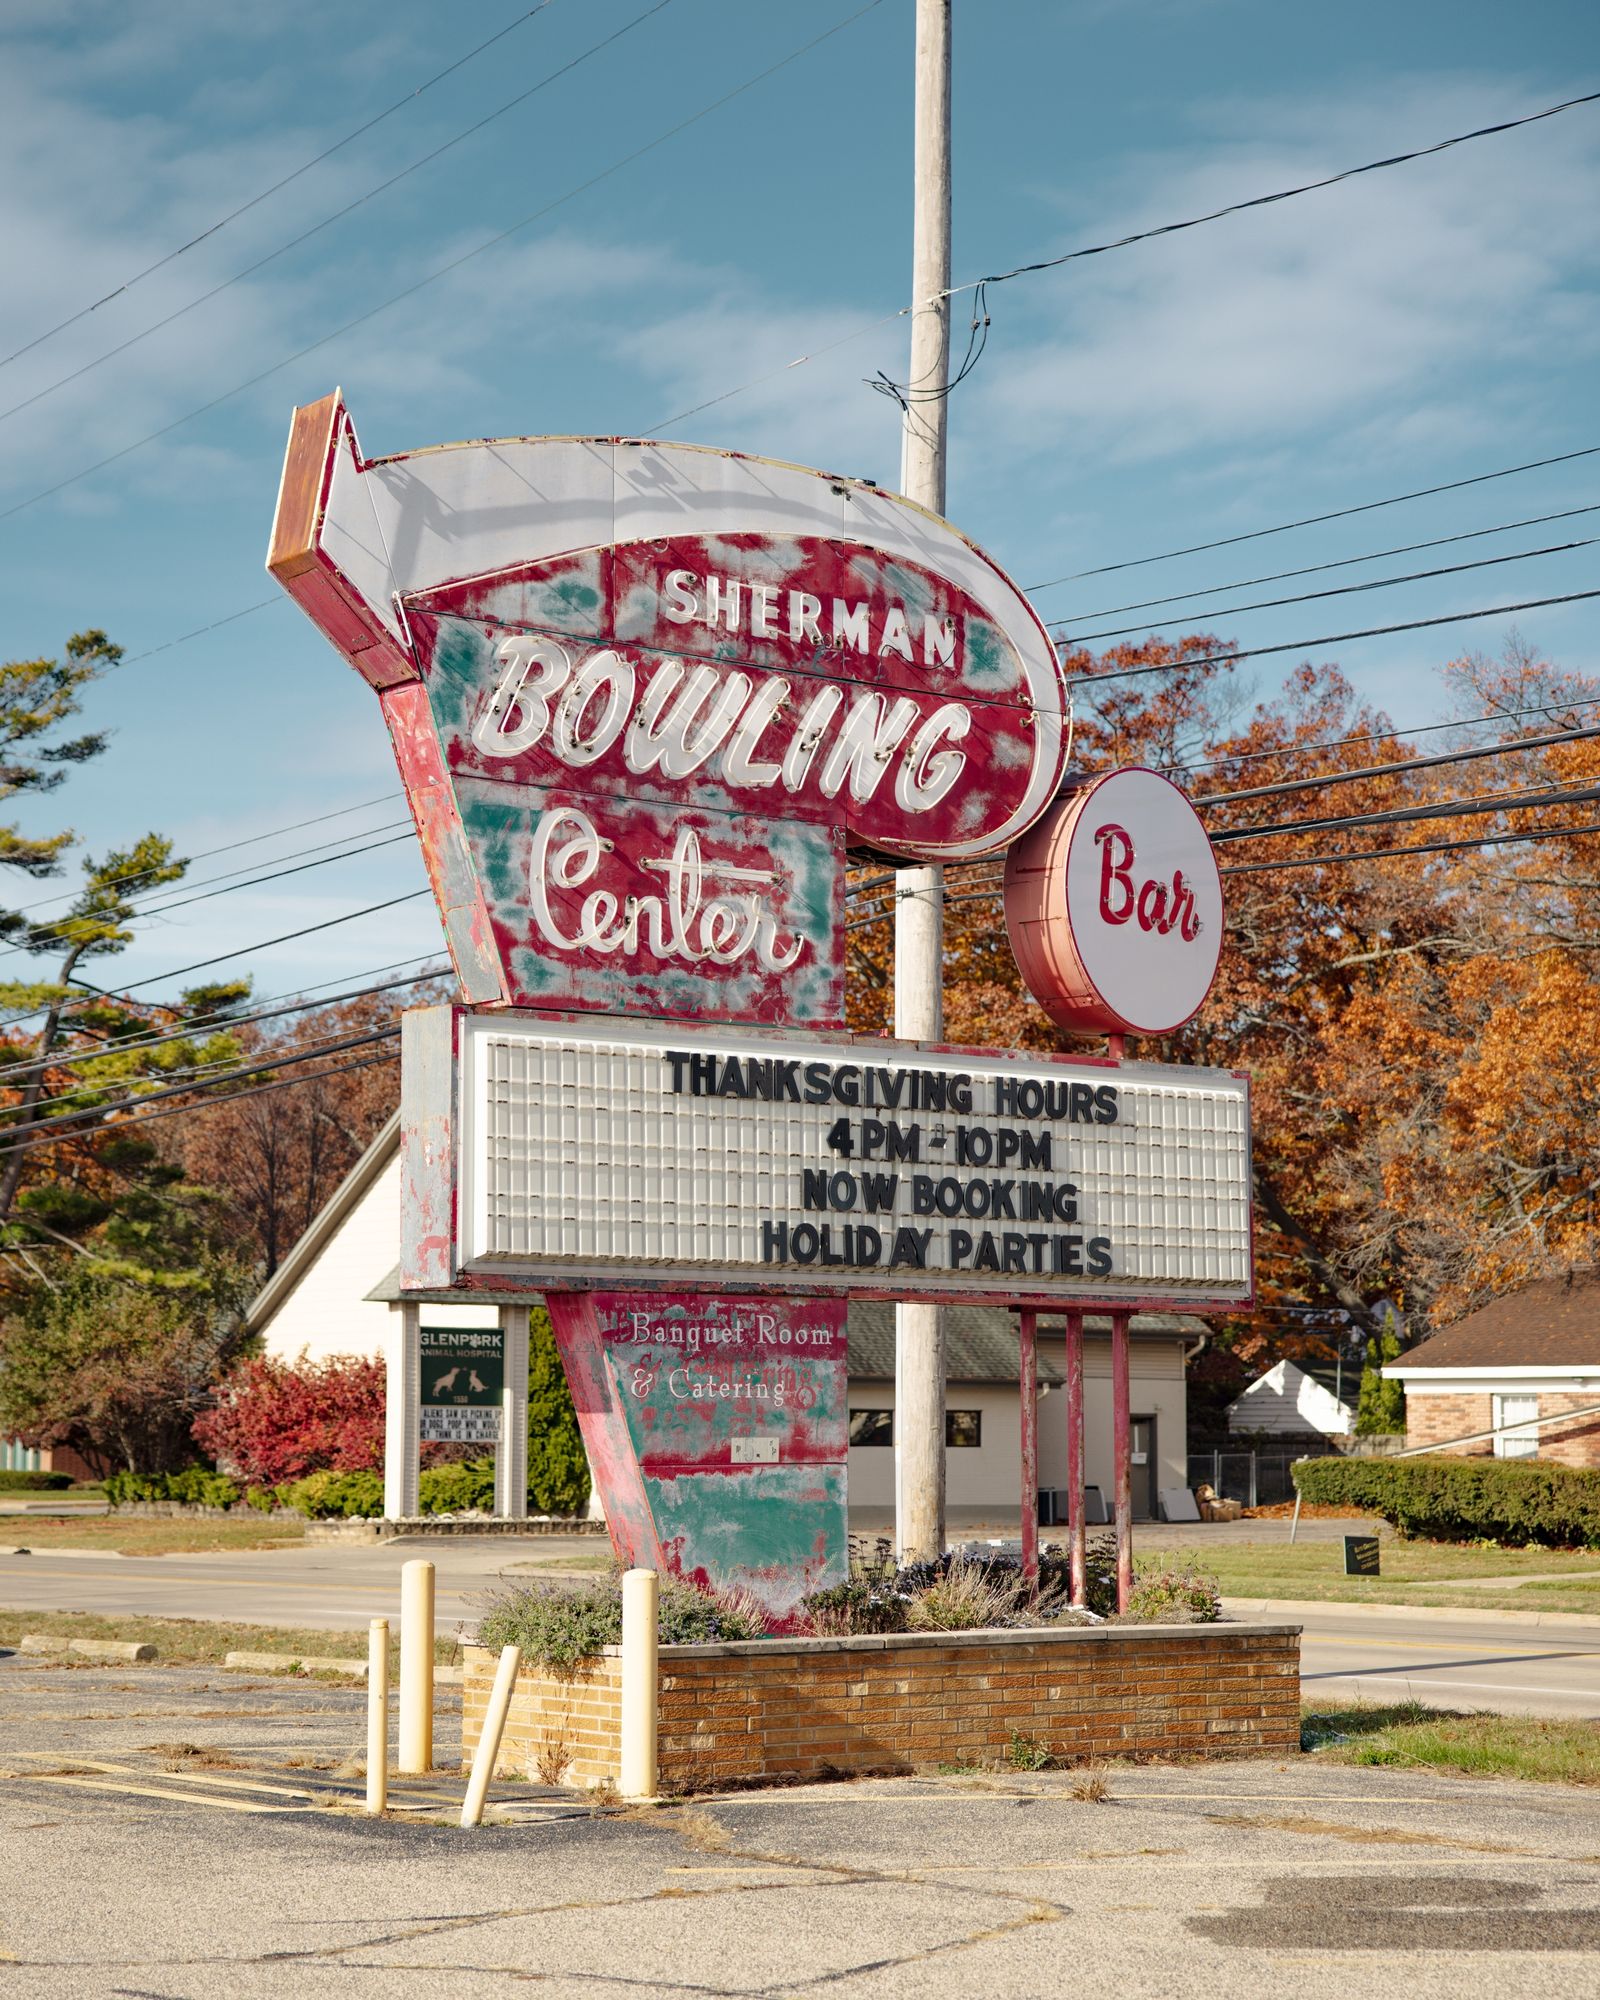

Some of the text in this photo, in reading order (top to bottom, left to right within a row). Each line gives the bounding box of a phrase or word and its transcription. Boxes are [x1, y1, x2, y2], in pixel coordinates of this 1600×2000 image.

[664, 569, 956, 669] SHERMAN
[471, 635, 972, 813] BOWLING
[530, 807, 805, 971] Center
[1095, 823, 1203, 943] Bar
[665, 1050, 1119, 1125] THANKSGIVING HOURS
[803, 1168, 1078, 1223] NOW BOOKING
[763, 1220, 1113, 1276] HOLIDAY PARTIES
[420, 1349, 502, 1358] ANIMAL HOSPITAL
[631, 1312, 832, 1352] Banquet Room
[446, 1408, 458, 1418] SAW
[461, 1409, 468, 1419] US
[470, 1409, 493, 1419] PICKING
[631, 1368, 654, 1398] &
[668, 1368, 785, 1407] Catering
